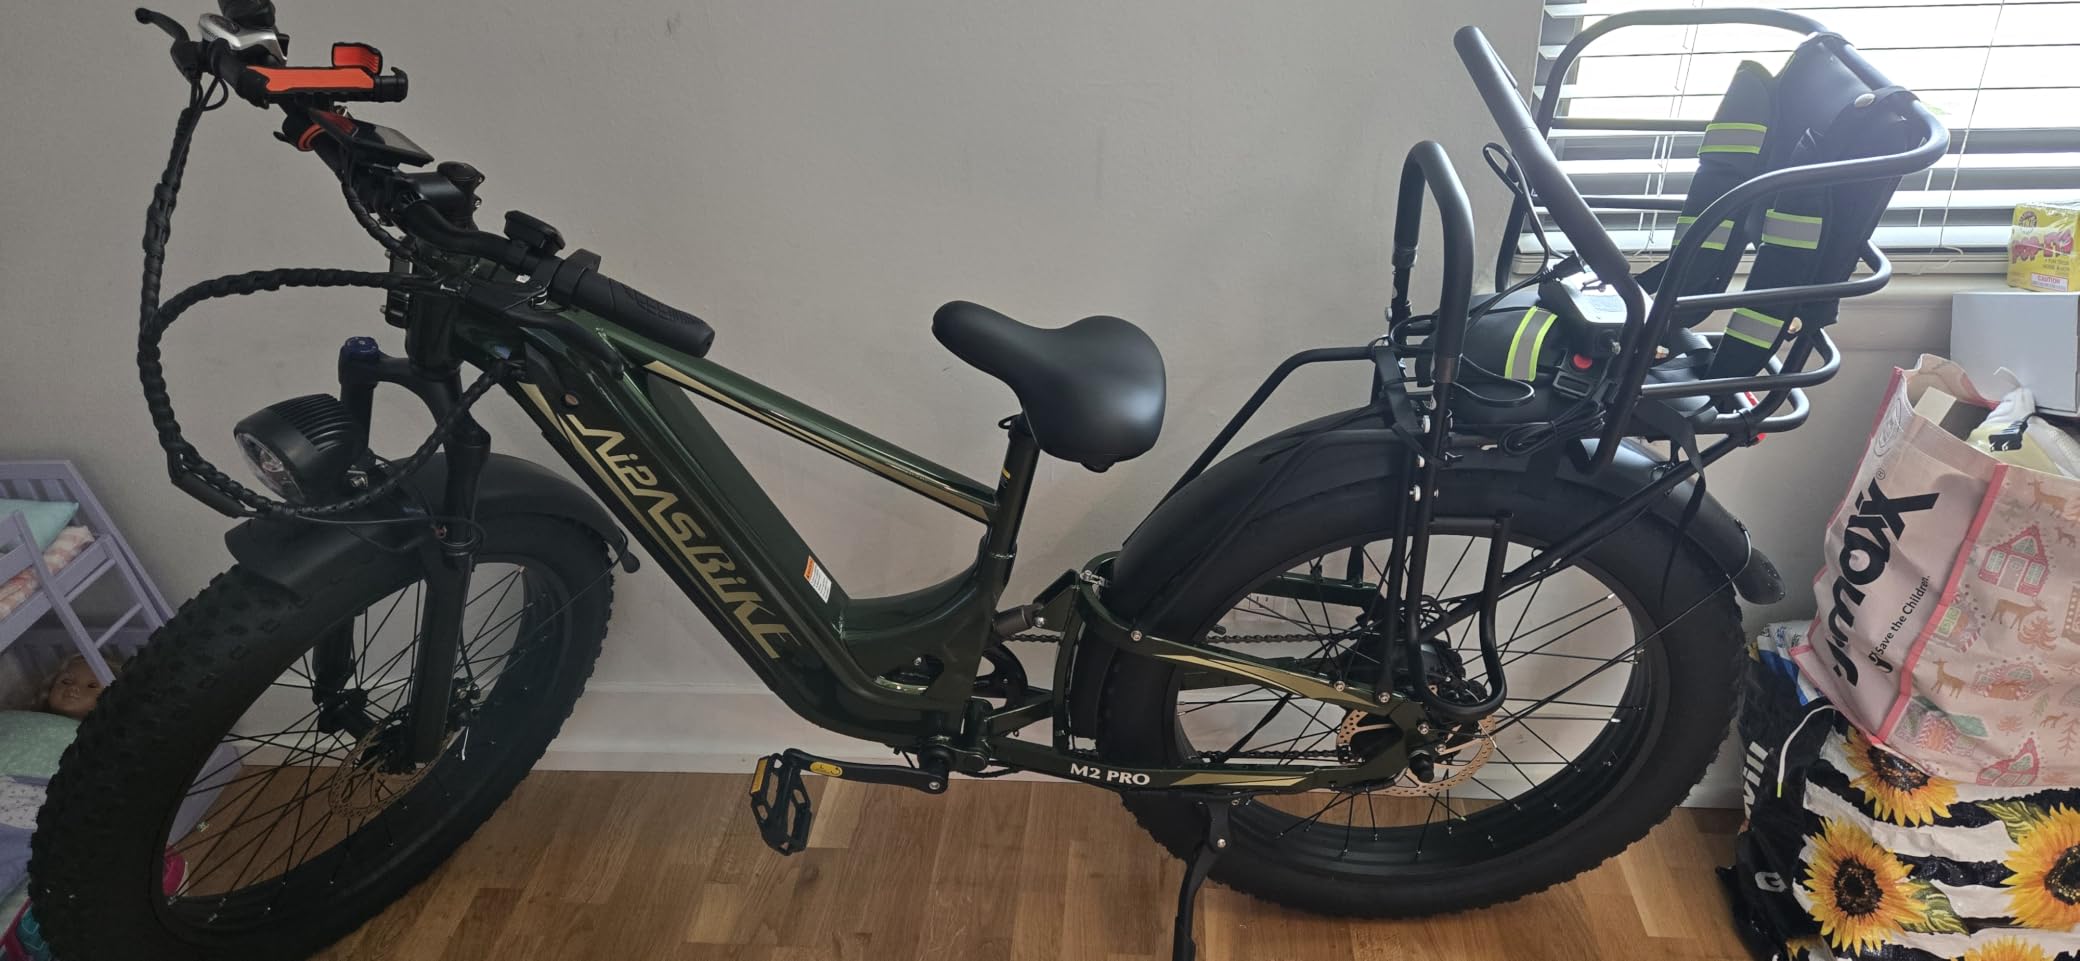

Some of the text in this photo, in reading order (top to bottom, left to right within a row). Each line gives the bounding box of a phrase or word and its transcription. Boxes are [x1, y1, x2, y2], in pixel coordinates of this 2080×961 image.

[1875, 632, 1894, 656] Save
[1891, 615, 1908, 632] the
[1070, 763, 1151, 786] M2 PRO
